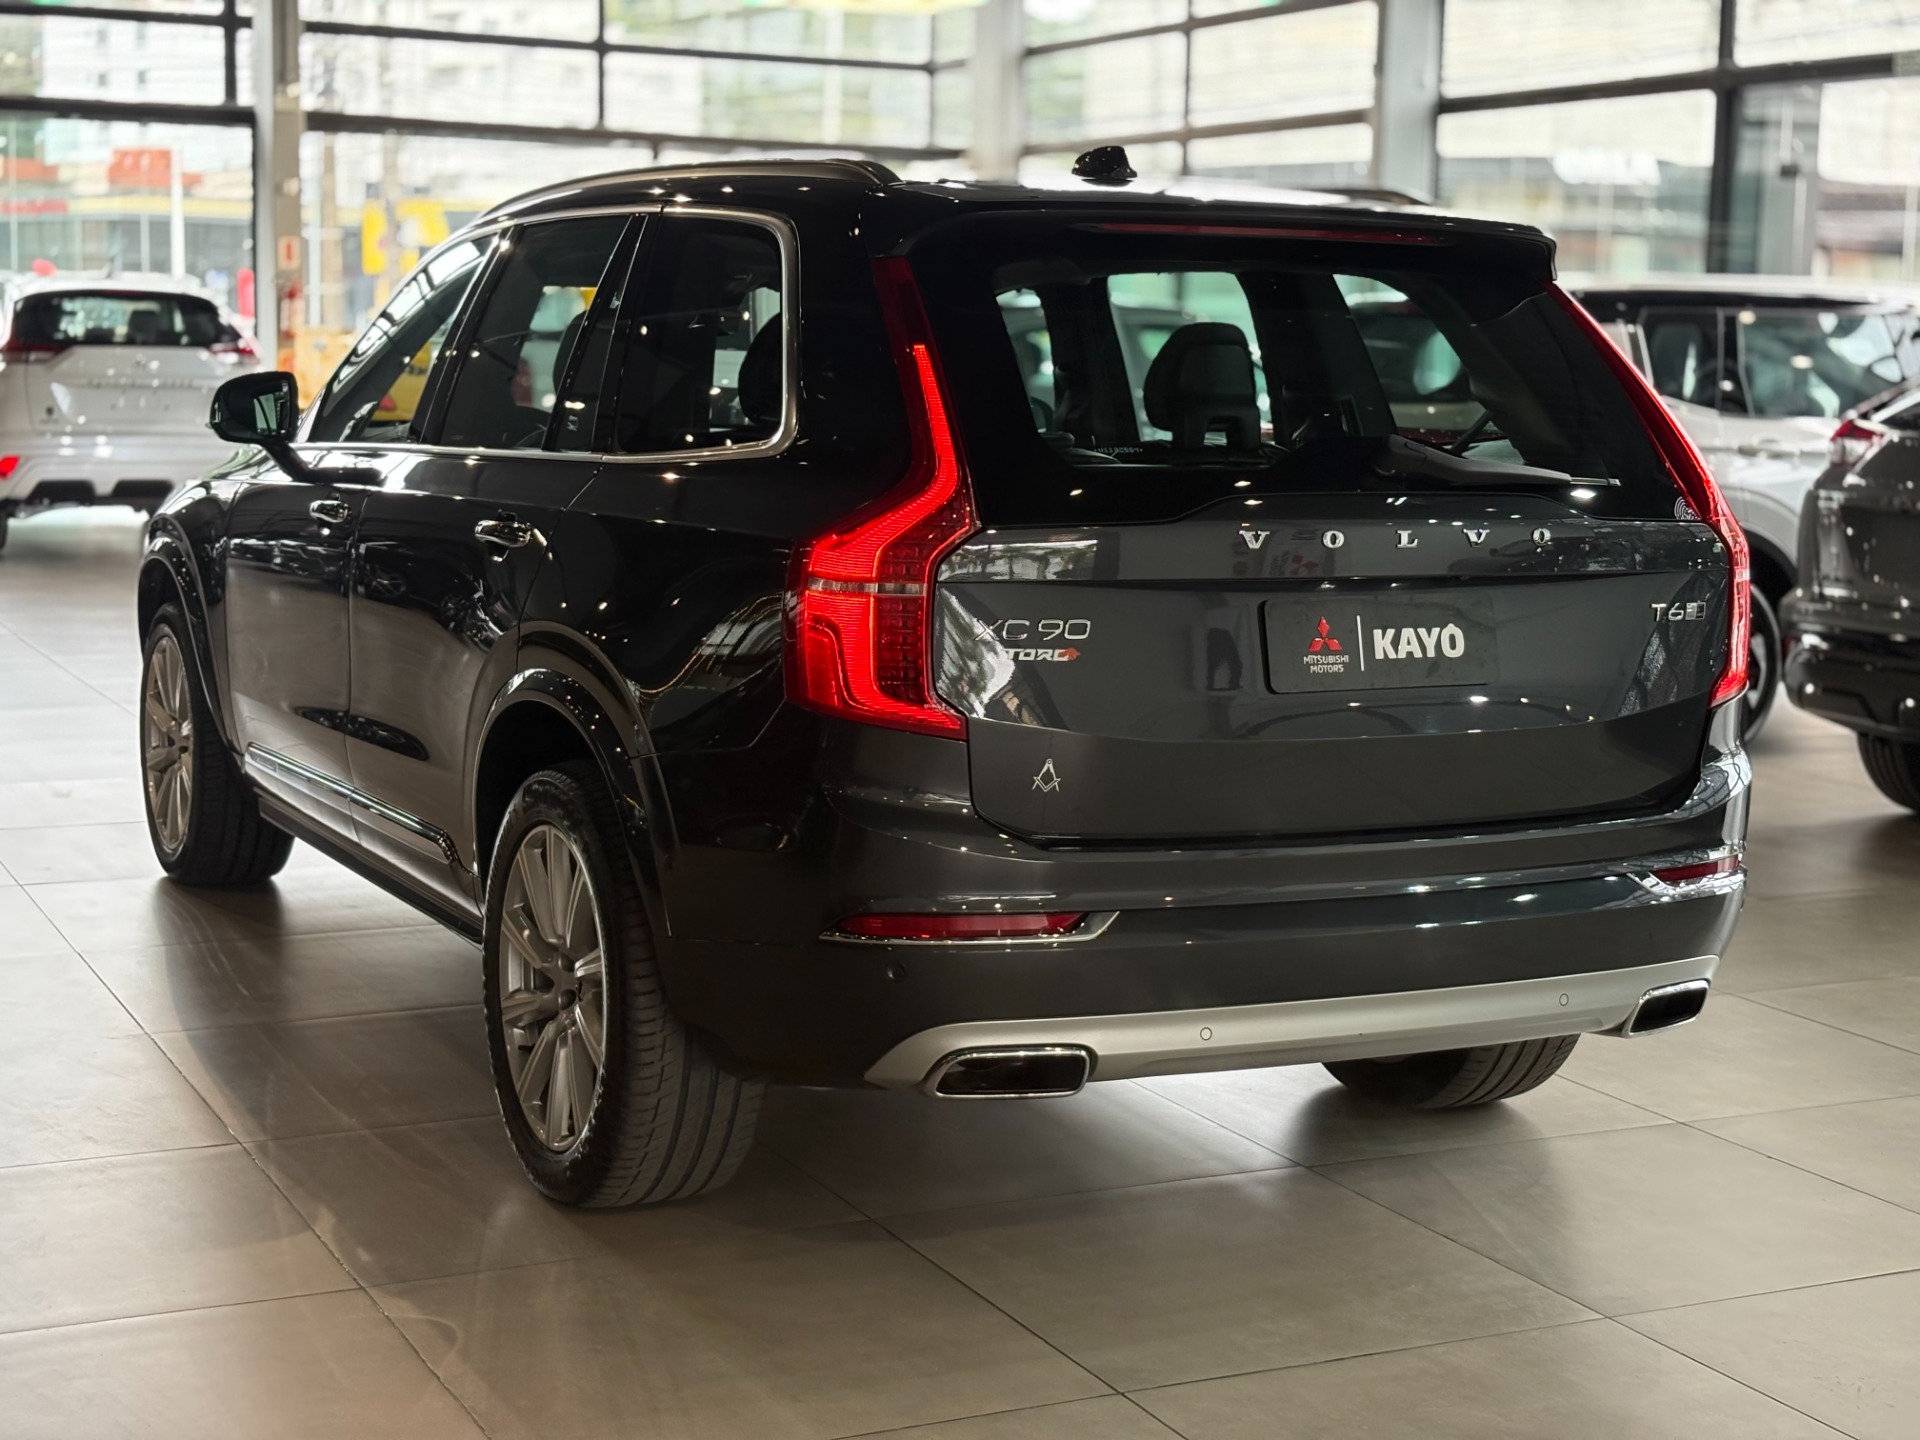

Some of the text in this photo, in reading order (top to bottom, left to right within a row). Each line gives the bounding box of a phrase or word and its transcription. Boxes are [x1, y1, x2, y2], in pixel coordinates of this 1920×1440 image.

[1239, 528, 1552, 549] VOLVO
[1651, 602, 1684, 621] T6
[1303, 655, 1349, 665] MITSUBISHI
[1310, 664, 1344, 674] MOTORS
